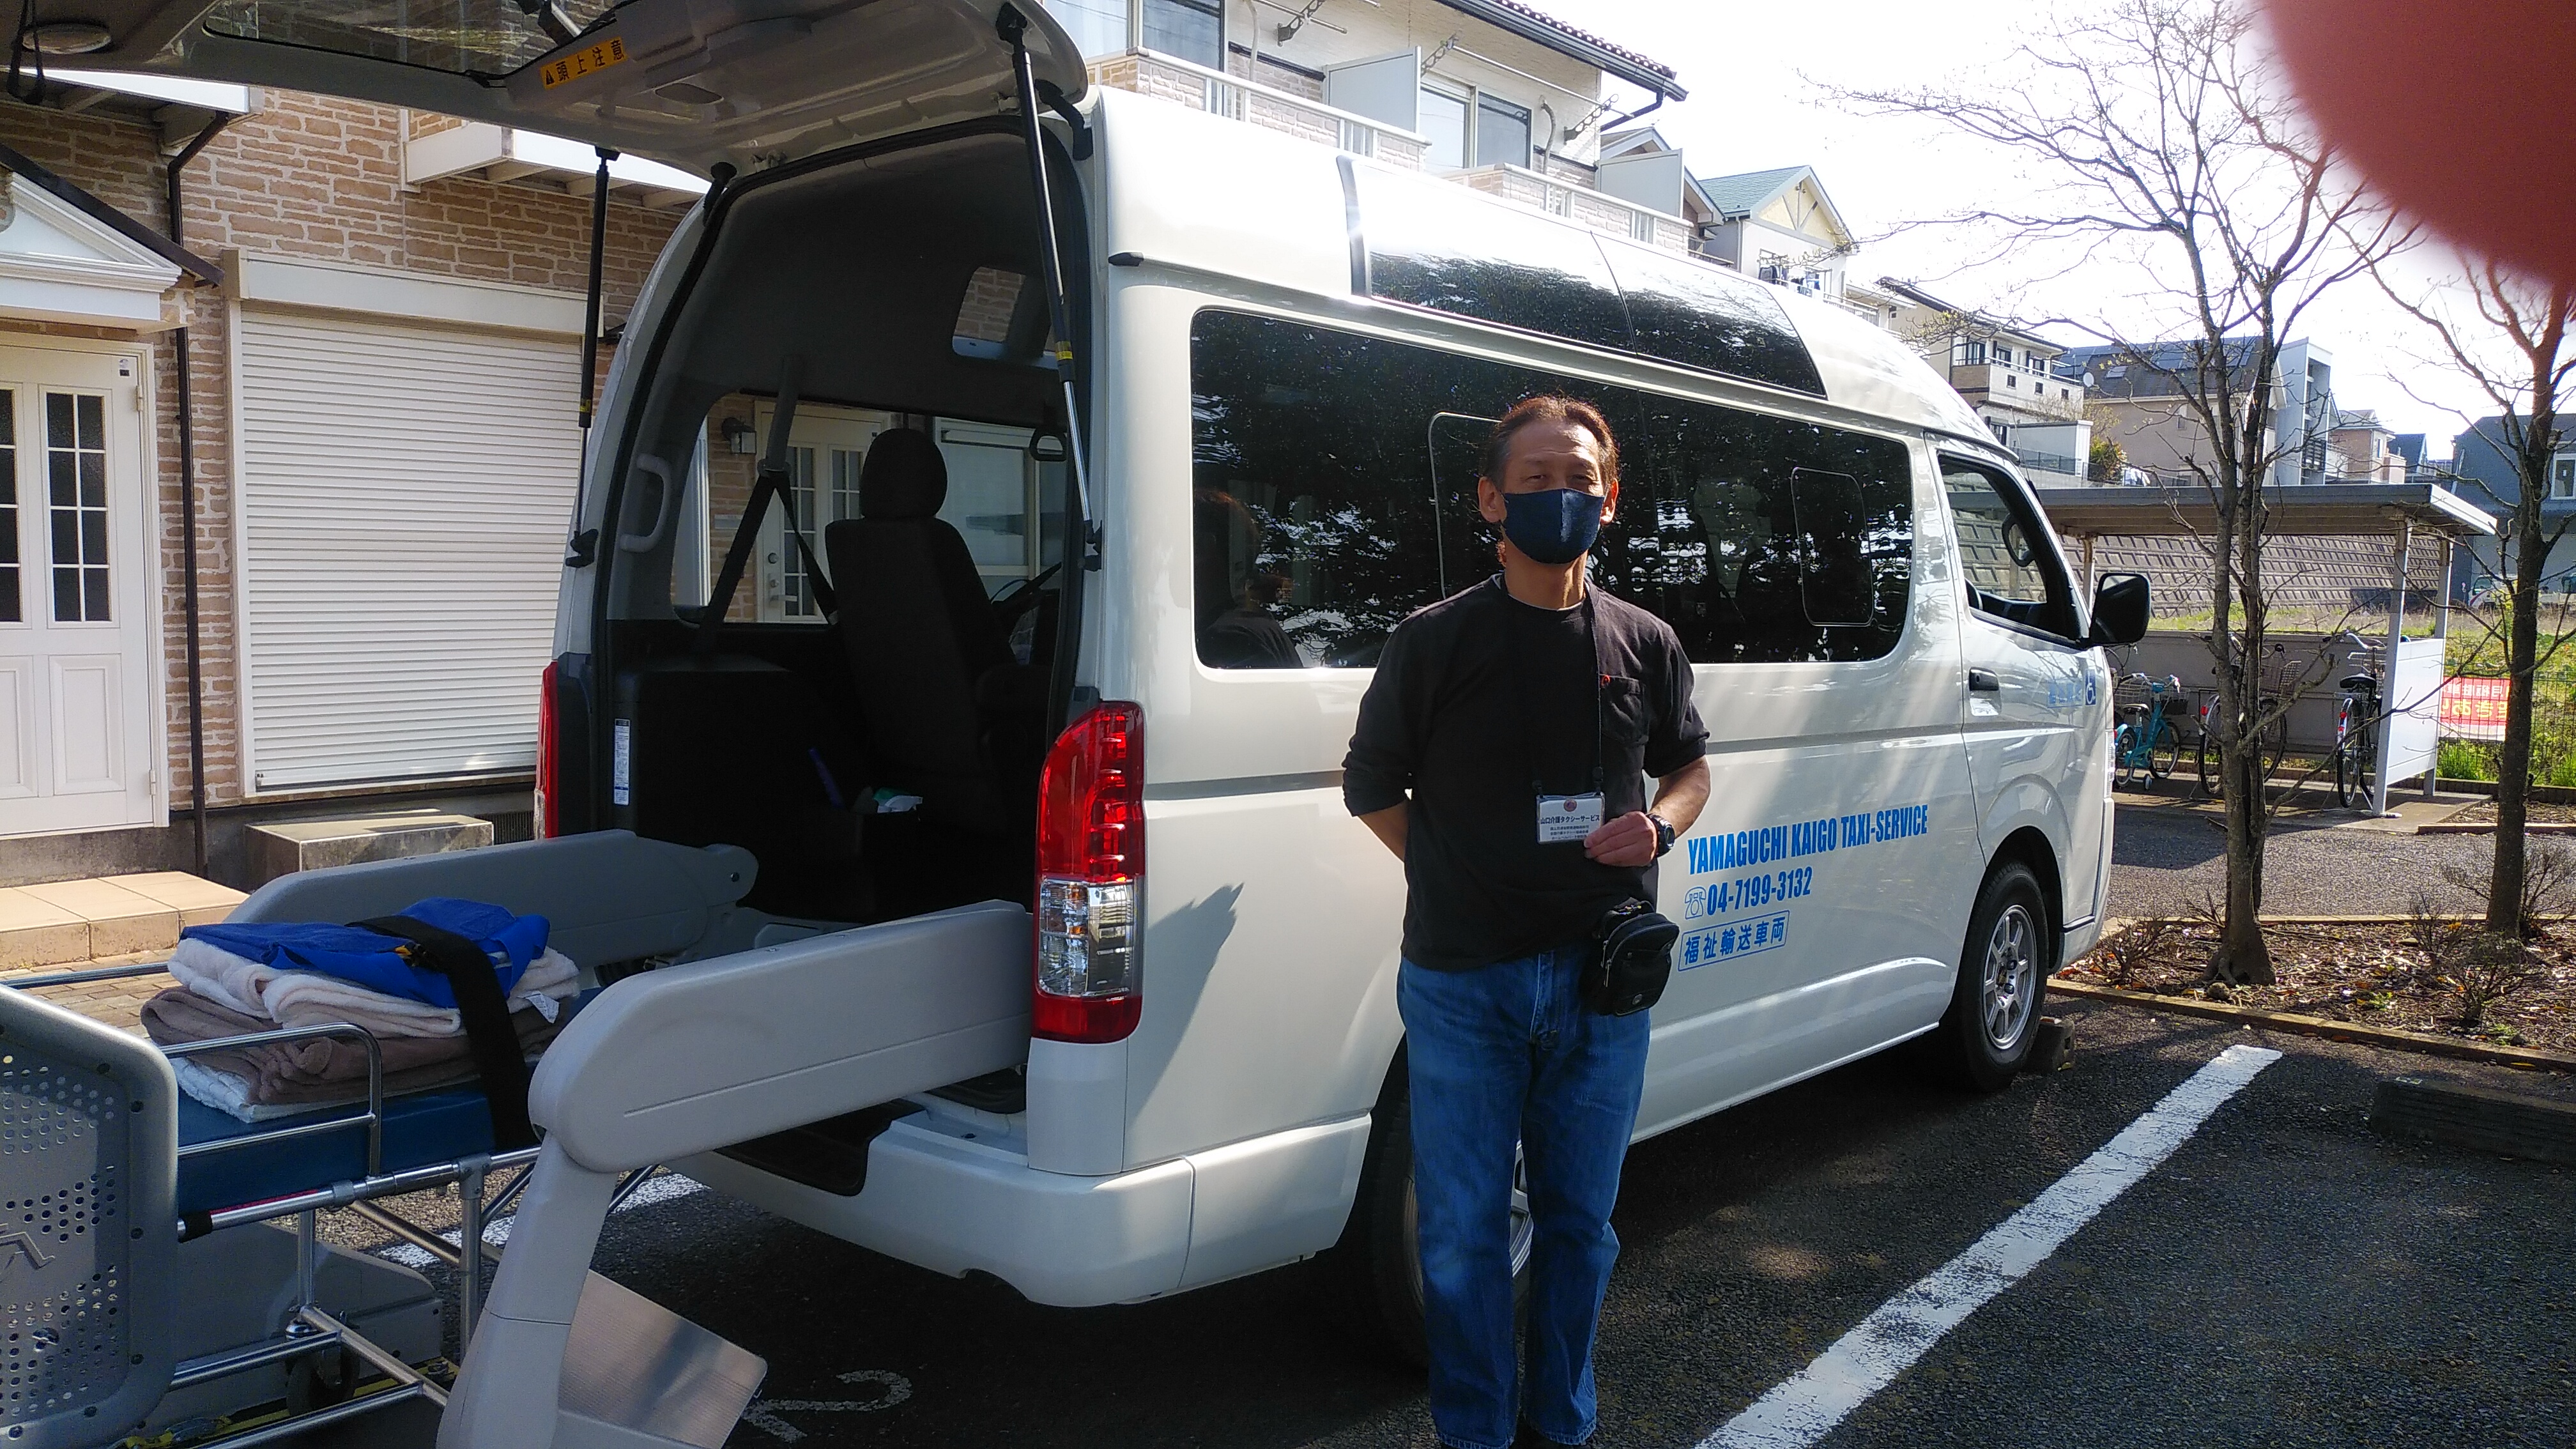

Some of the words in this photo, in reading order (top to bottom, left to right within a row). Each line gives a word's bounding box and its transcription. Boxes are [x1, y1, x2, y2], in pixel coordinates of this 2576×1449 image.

[556, 40, 625, 81] 頭上注意
[1540, 814, 1600, 825] 山口介護タクシーサービス
[1687, 825, 1787, 875] YAMAGUCHI
[1791, 817, 1837, 857] KAIGO
[1841, 804, 1928, 848] TAXI-SERVICE
[1706, 866, 1813, 916] 04-7199-3132
[1684, 916, 1786, 965] 福祉輸送車両
